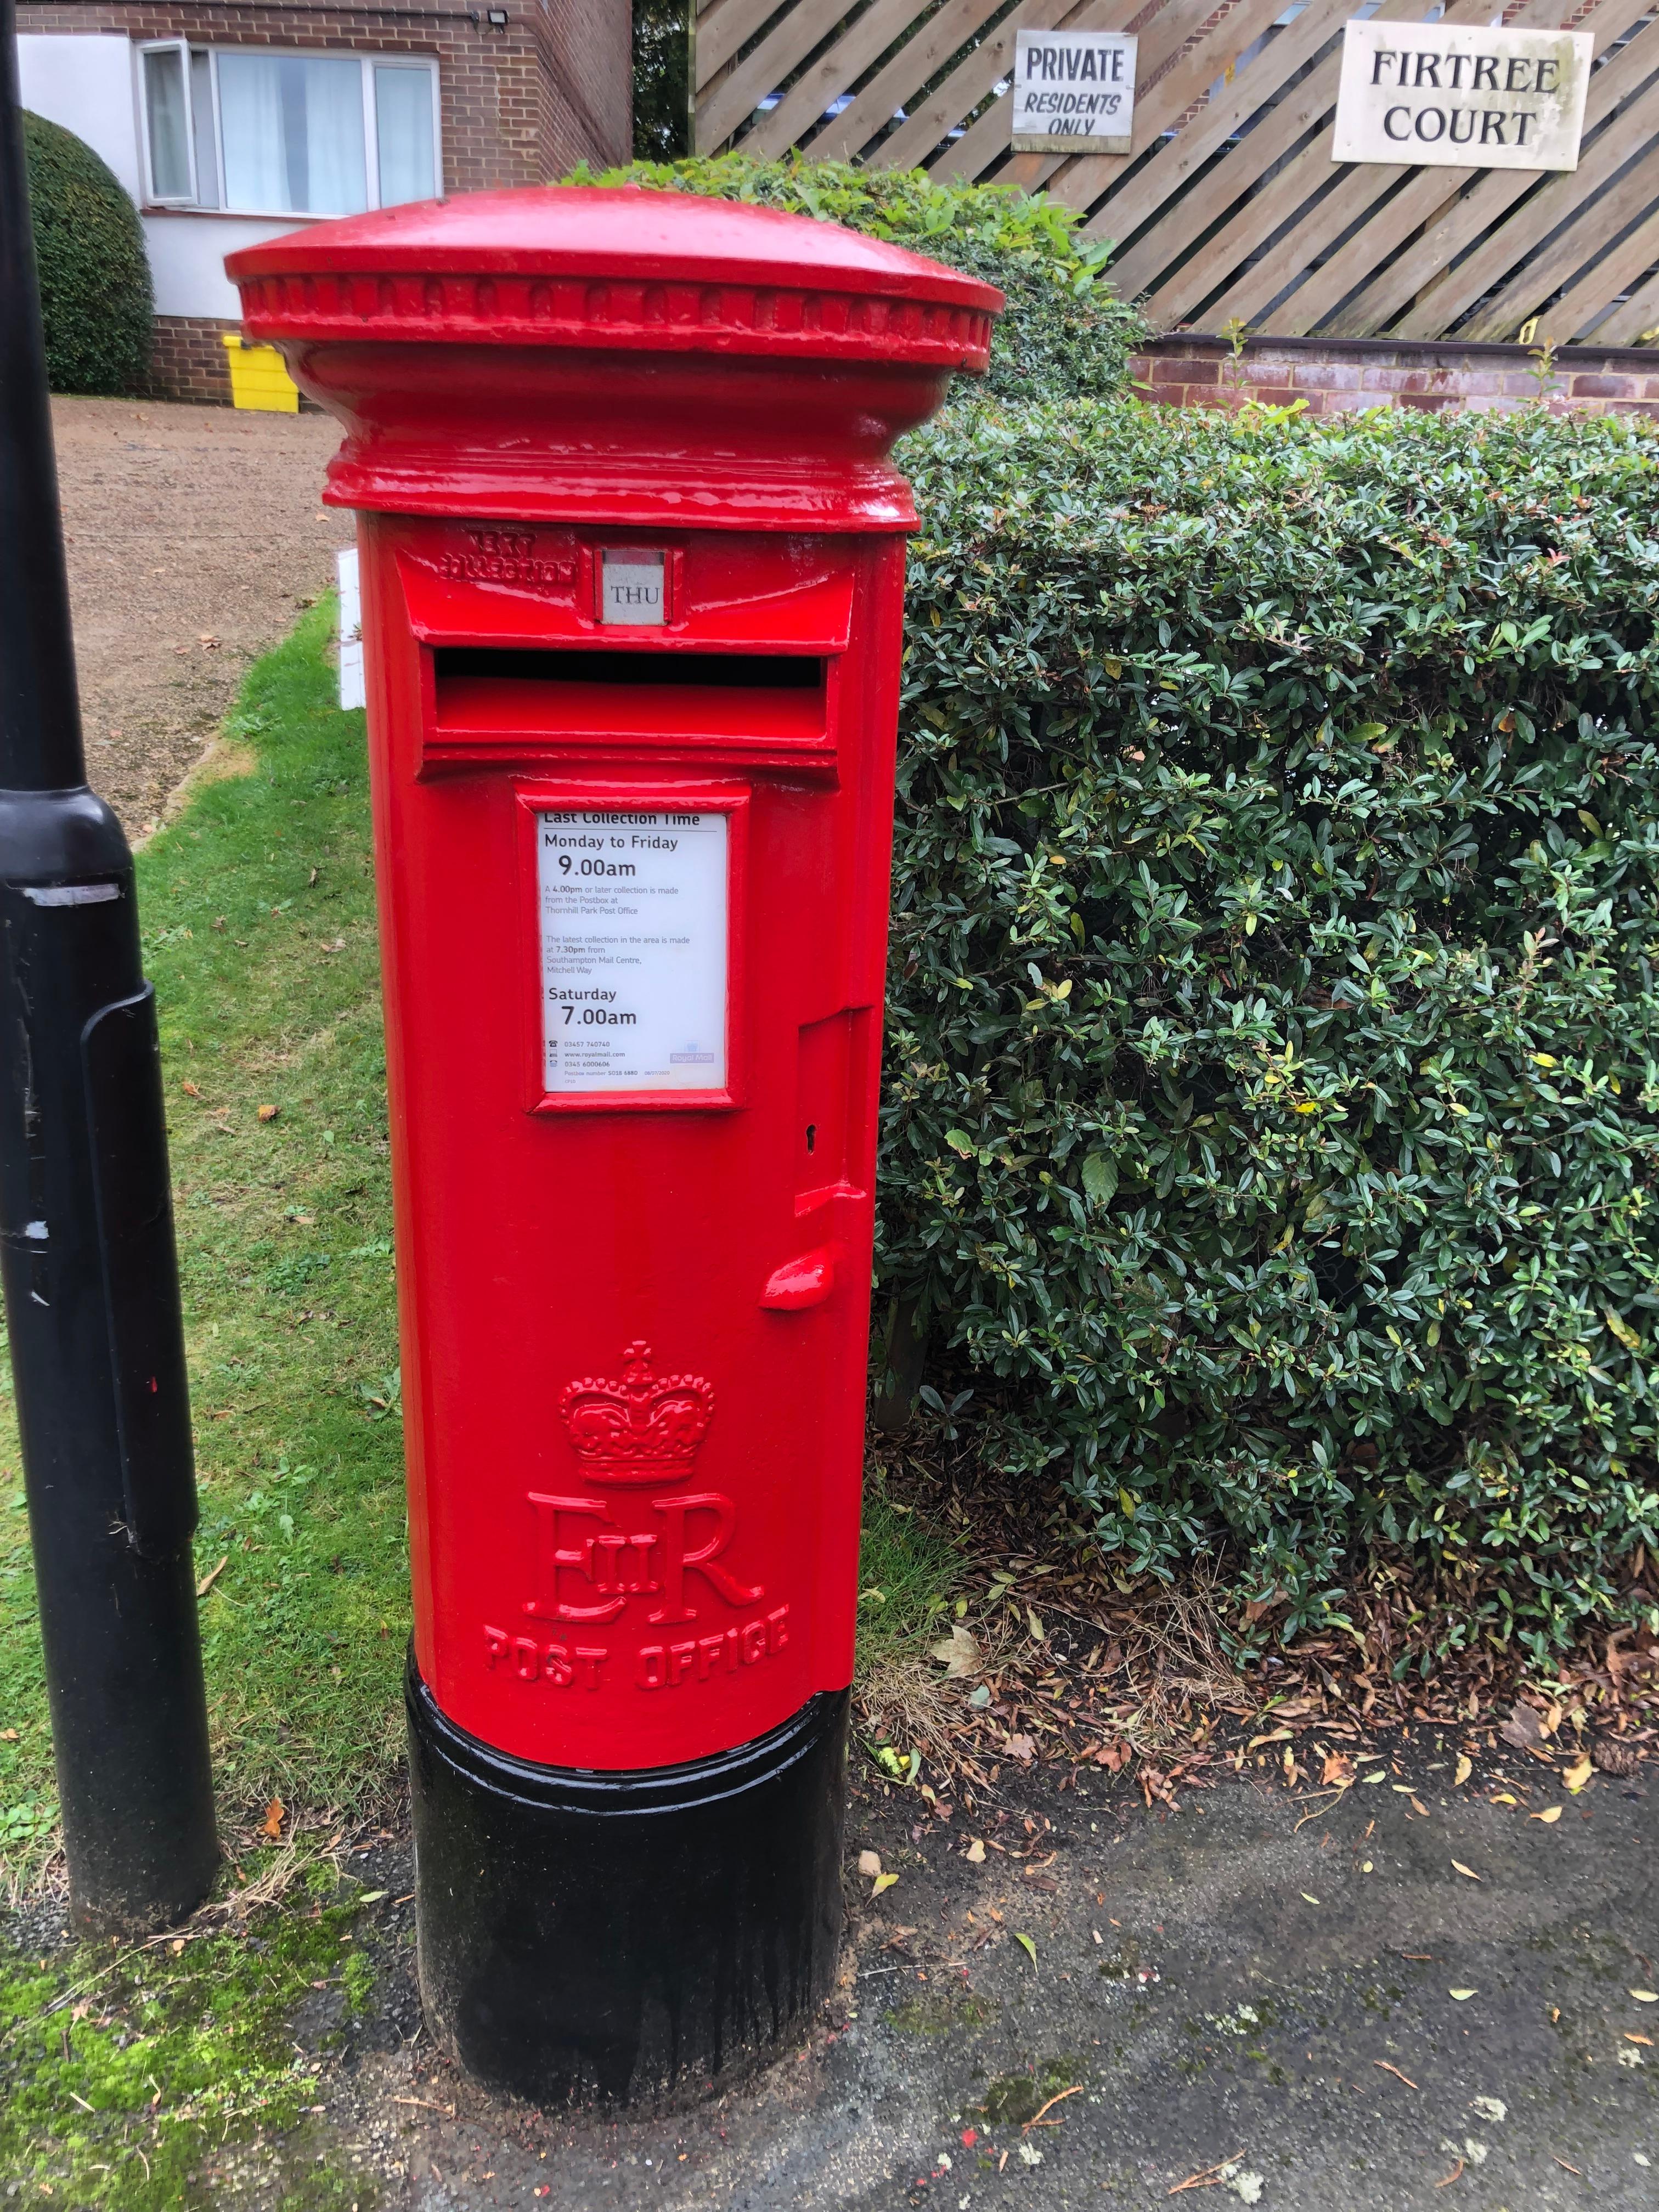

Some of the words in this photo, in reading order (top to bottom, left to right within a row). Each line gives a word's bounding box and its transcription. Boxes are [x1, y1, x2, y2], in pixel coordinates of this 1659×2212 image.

[1027, 47, 1124, 81] PRIVATE
[1370, 50, 1560, 93] FIRTREE
[1024, 92, 1121, 115] RESIDENTS
[1048, 118, 1095, 136] ONLY
[1384, 106, 1537, 145] COURT
[610, 585, 660, 604] THU
[544, 814, 578, 823] Last
[583, 813, 657, 825] Collection
[665, 814, 700, 825] Time
[545, 834, 604, 850] Monday
[610, 837, 624, 848] to
[631, 836, 678, 851] Friday
[558, 855, 636, 876] 9.00am
[553, 886, 583, 894] 4.00pm
[556, 946, 585, 955] 7.30pm
[547, 956, 596, 966] Southampton
[616, 956, 642, 965] Centre,
[576, 967, 592, 975] Way
[549, 988, 617, 1003] Saturday
[561, 1006, 636, 1025] 7.00am
[484, 1624, 609, 1691] POST
[636, 1603, 790, 1691] OFFICE
